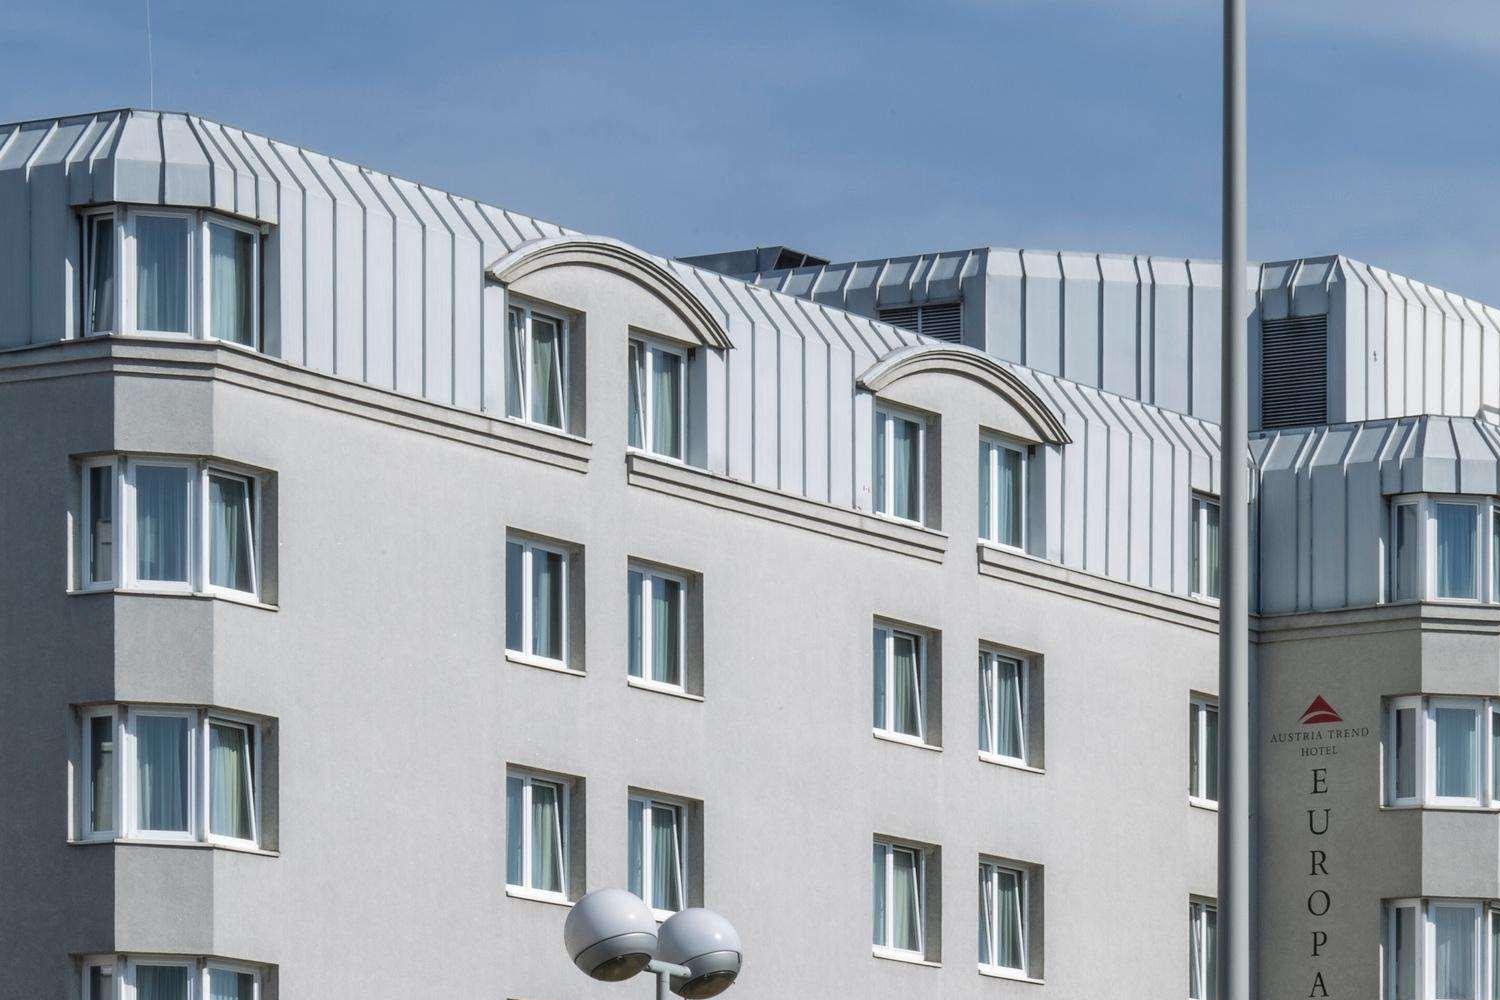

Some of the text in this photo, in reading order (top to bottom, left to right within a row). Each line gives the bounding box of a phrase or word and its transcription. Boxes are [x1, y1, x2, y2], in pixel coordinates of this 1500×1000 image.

[1269, 727, 1370, 744] AUSTRIA TREND
[1300, 746, 1338, 757] HOTEL
[1306, 768, 1331, 998] EUROPA
